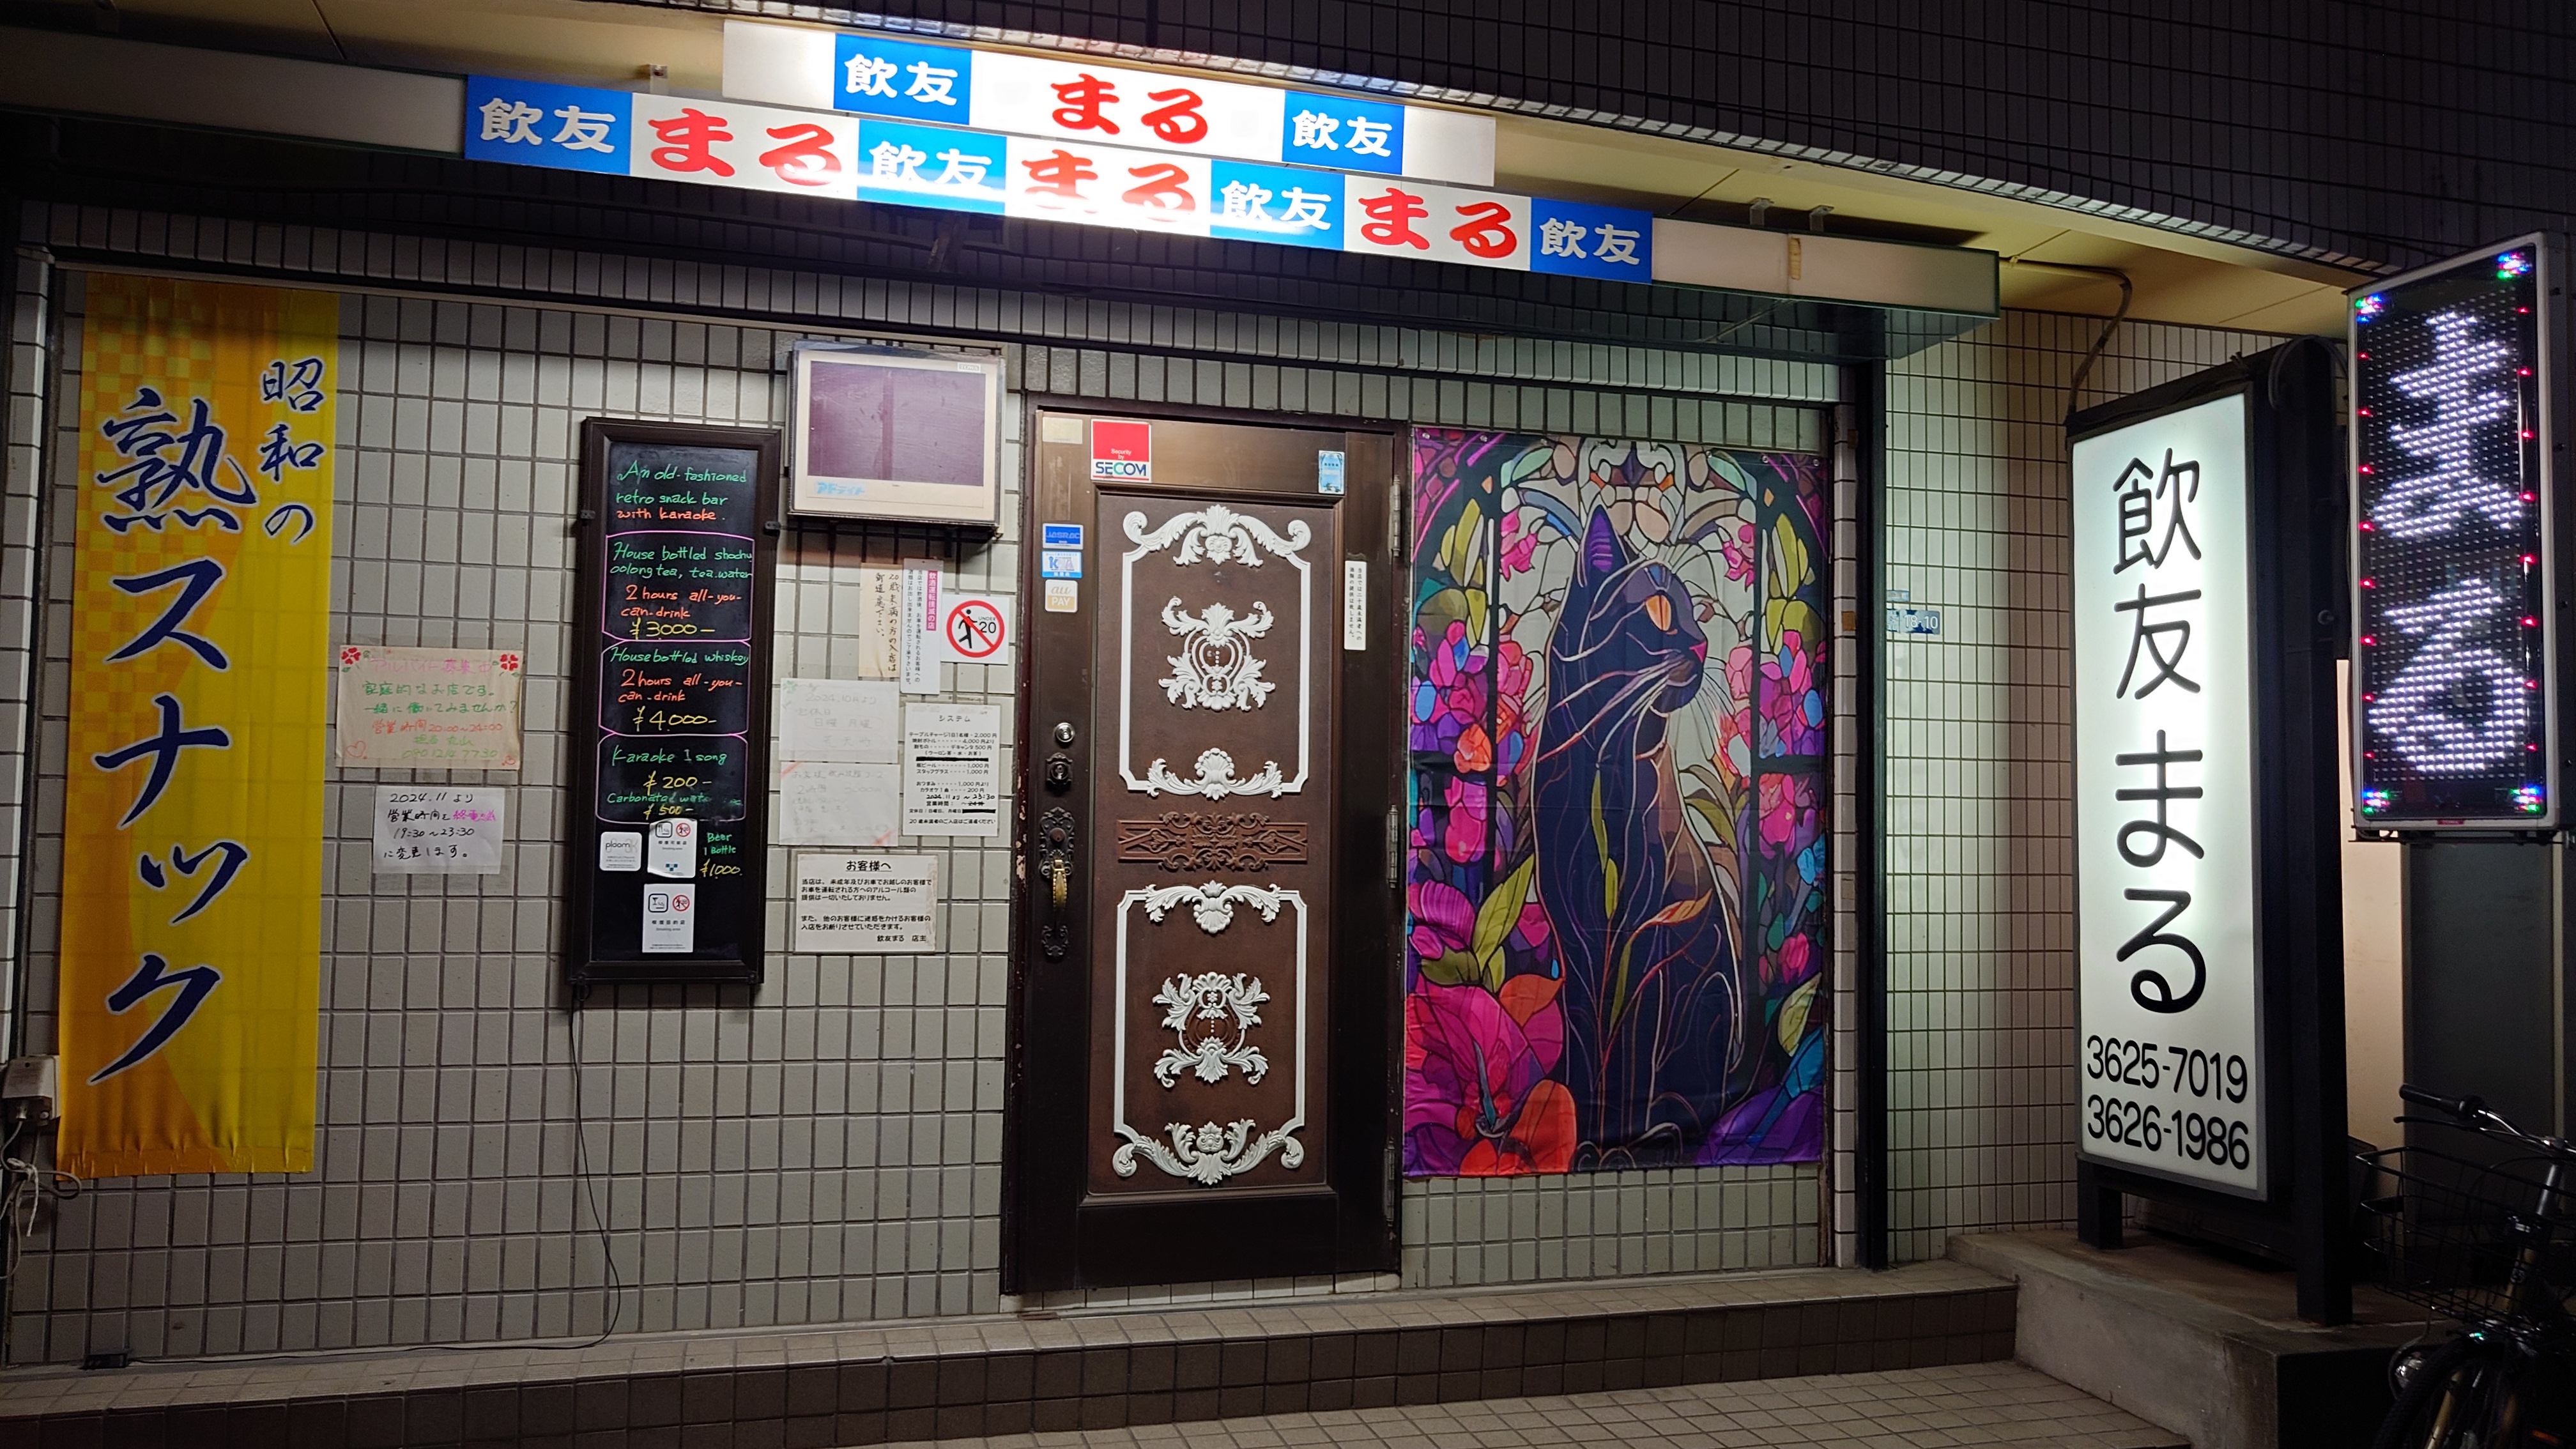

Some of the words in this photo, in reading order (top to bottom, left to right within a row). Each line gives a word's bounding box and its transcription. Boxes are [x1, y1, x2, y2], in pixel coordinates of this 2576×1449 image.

[844, 52, 958, 106] 飲友
[1050, 72, 1209, 144] まる
[1291, 109, 1393, 158] 飲友
[478, 97, 617, 154] 飲友
[648, 107, 841, 186] まる
[869, 141, 992, 190] 飲友
[1022, 148, 1197, 222] まる
[1220, 180, 1331, 231] 飲友
[1358, 187, 1518, 259] まる
[1540, 217, 1641, 265] 飲友
[261, 355, 325, 546] 昭和の
[617, 460, 650, 480] An
[1096, 461, 1146, 477] SECOM
[616, 489, 654, 504] retro
[659, 490, 696, 504] snack
[703, 492, 728, 505] bar
[617, 509, 652, 519] with
[1046, 530, 1080, 540] JASRAC
[2367, 310, 2527, 773] まる
[613, 542, 655, 561] House
[662, 545, 707, 560] bottled
[610, 565, 652, 579] oolong
[657, 565, 683, 579] tea,
[626, 585, 637, 601] 2
[642, 586, 678, 601] hours
[1051, 585, 1071, 595] au
[927, 571, 938, 630] 飲酒運転撲滅の店
[1051, 595, 1071, 606] PAY
[620, 607, 691, 619] can-drink
[980, 622, 997, 633] 20
[610, 647, 650, 663] House
[704, 649, 749, 665] whiskey
[622, 668, 636, 687] 2
[638, 671, 671, 686] hours
[363, 681, 494, 696] 家庭的なお店です。
[86, 387, 258, 1088] 熟スナック
[2112, 447, 2206, 1015] 飲友まる
[611, 745, 675, 767] Karaoke
[695, 751, 727, 766] song
[605, 840, 631, 850] ploom
[707, 832, 732, 843] Beer
[384, 844, 468, 860] に変更します。
[710, 844, 737, 855] Bottle
[846, 860, 892, 871] お客様へ
[2087, 1035, 2248, 1105] 3625-7019
[2087, 1094, 2250, 1170] 3626-1986
